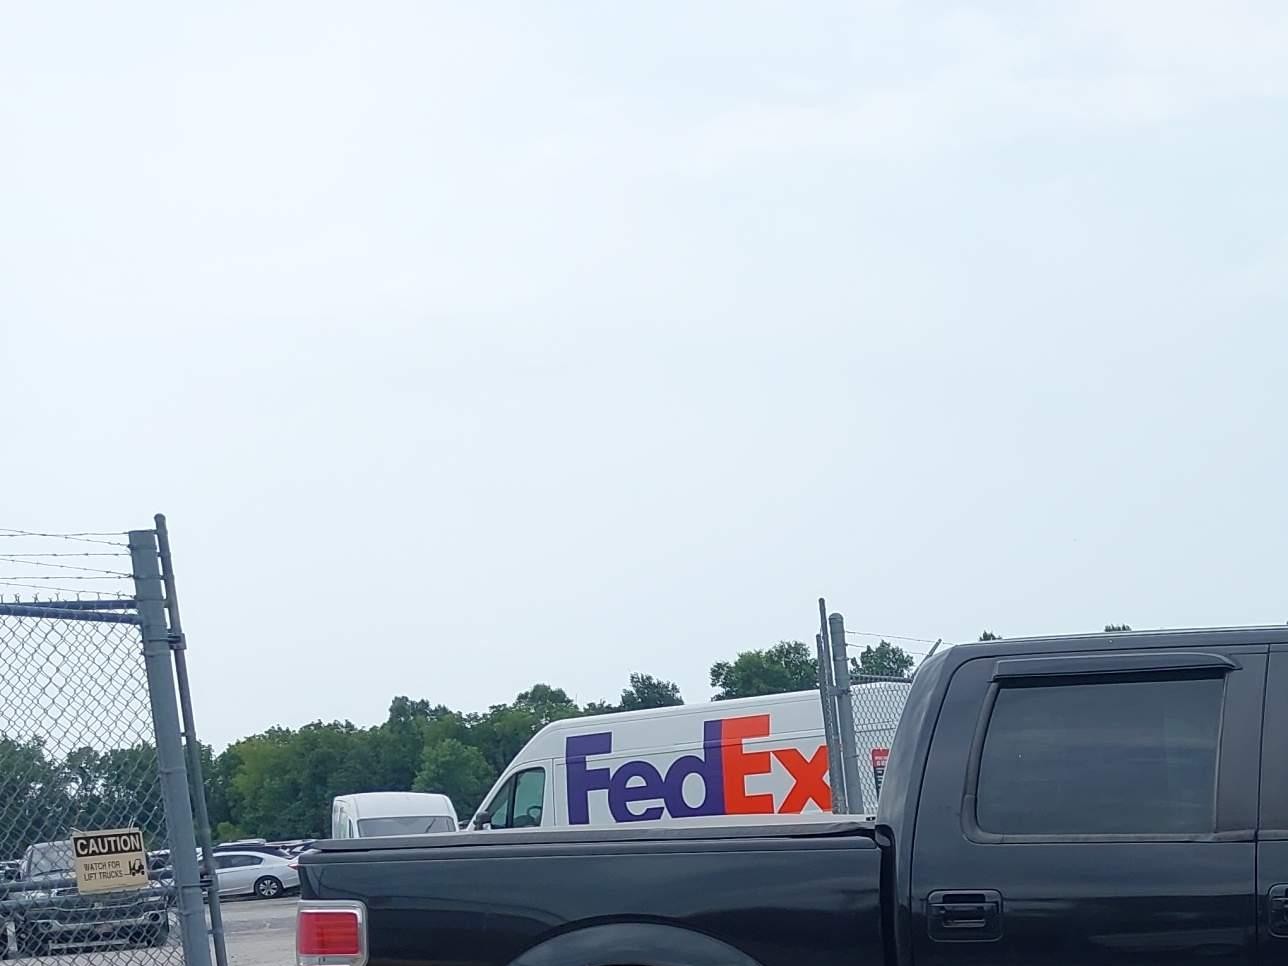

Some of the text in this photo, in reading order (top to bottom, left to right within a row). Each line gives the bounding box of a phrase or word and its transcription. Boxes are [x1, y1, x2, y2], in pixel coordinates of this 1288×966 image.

[566, 713, 834, 825] FedEx
[77, 835, 141, 855] CAUTION
[83, 861, 121, 871] WATCH FOR
[83, 870, 123, 881] LIFT TRUCKS
